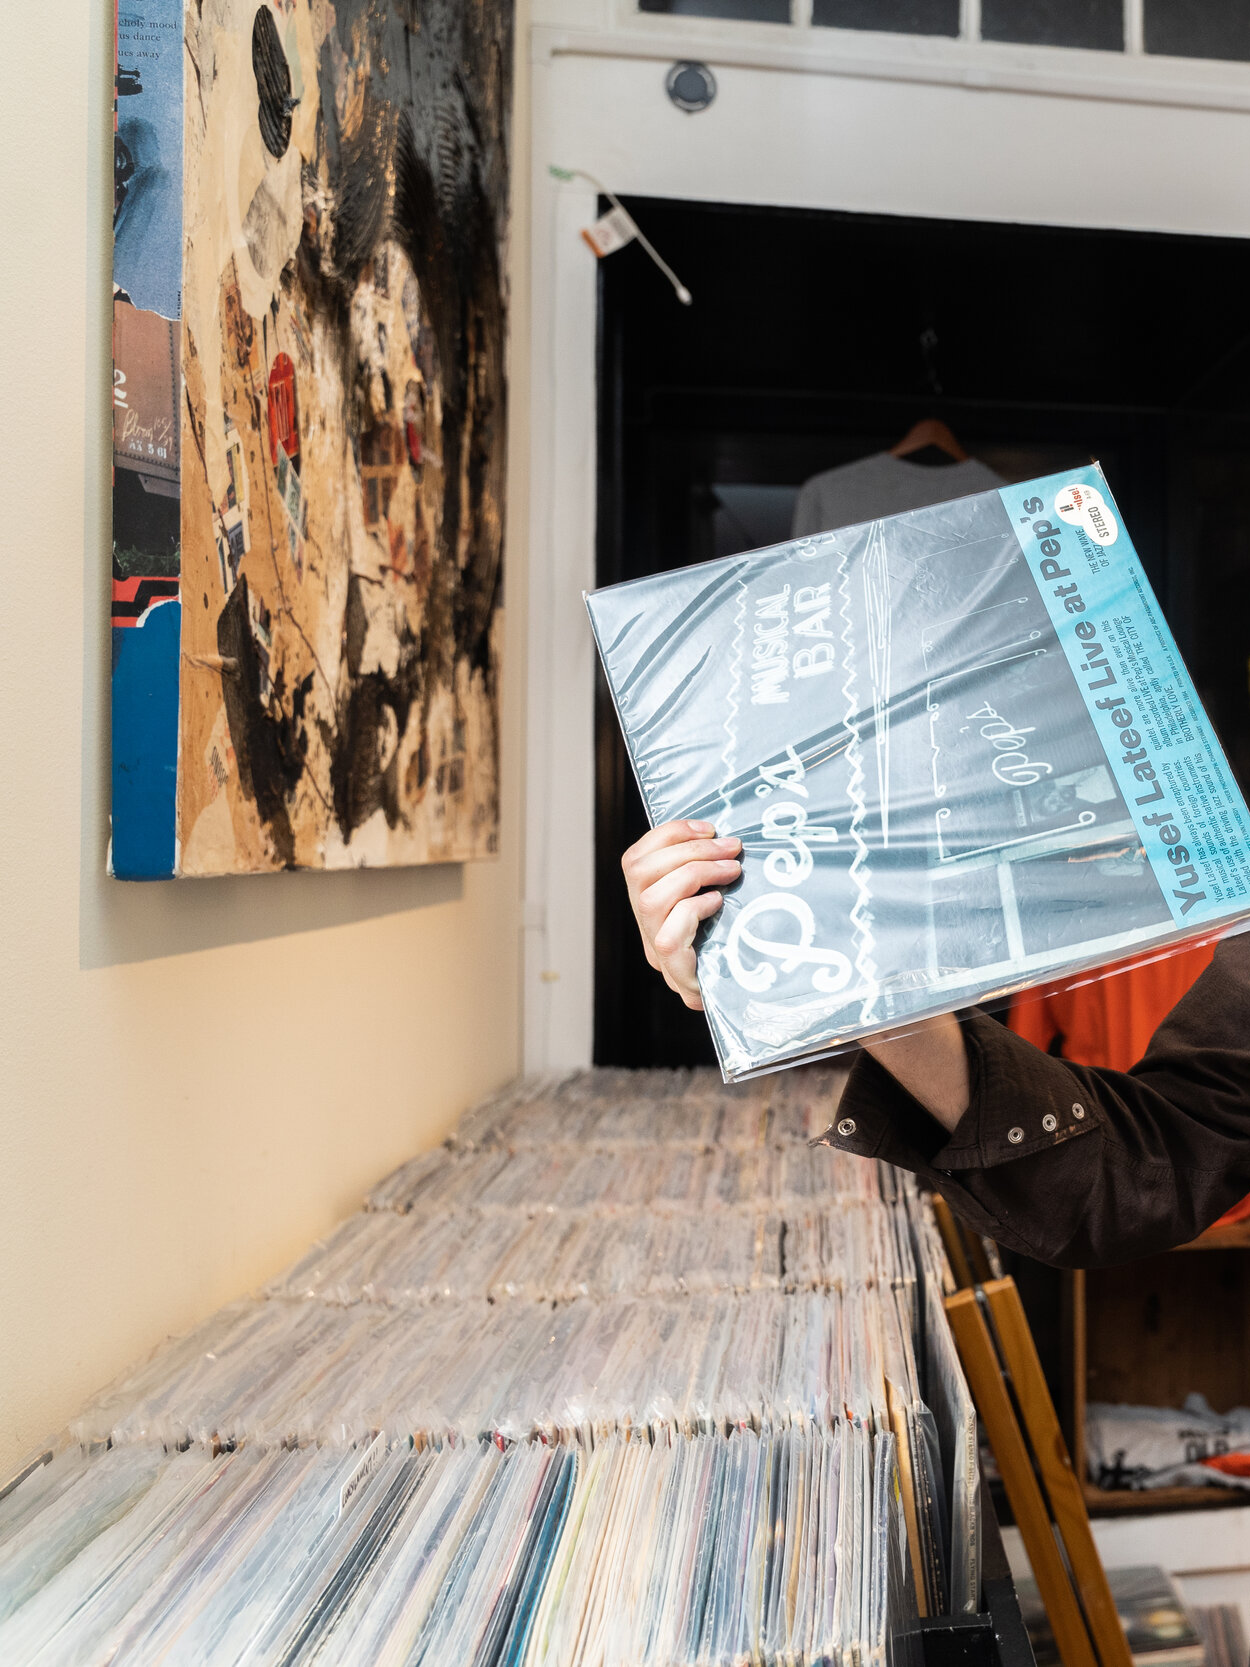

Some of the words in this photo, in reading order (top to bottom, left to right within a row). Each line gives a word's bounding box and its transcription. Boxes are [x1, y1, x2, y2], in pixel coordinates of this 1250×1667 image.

[150, 21, 176, 29] mood
[133, 32, 160, 41] dance
[136, 52, 160, 60] away
[1087, 506, 1109, 537] STEREO
[1020, 496, 1071, 580] Pep's
[1075, 528, 1089, 546] WAVE
[1082, 546, 1095, 561] NEW
[1093, 544, 1106, 557] JAZZ
[1088, 561, 1100, 574] THE
[1098, 558, 1109, 567] OF
[1053, 582, 1086, 613] at
[1100, 619, 1112, 632] this
[1112, 617, 1127, 639] Lounge
[1121, 614, 1132, 623] OF
[793, 582, 836, 679] BAR
[1107, 634, 1117, 642] on
[1125, 625, 1139, 639] CITY
[750, 583, 791, 706] MUSICAL
[1111, 645, 1124, 658] ever
[1120, 638, 1137, 662] Musical
[1132, 641, 1145, 654] THE
[1074, 620, 1117, 690] Live
[1118, 660, 1130, 675] than
[1130, 661, 1144, 679] Pep's
[1139, 656, 1154, 674] called
[1125, 677, 1138, 692] alive
[1140, 686, 1153, 700] LIVE
[1148, 677, 1162, 692] aptly
[1163, 684, 1178, 703] LOVE.
[1132, 694, 1146, 711] more
[1140, 713, 1151, 724] are
[1146, 700, 1164, 727] recorded
[1156, 695, 1179, 735] Philadelphia,
[1171, 704, 1194, 741] BROTHERLY
[960, 700, 1053, 786] Pep's
[1145, 727, 1162, 750] quintet
[1158, 727, 1172, 747] album
[1095, 697, 1164, 805] Lateef
[1193, 752, 1204, 763] his
[1160, 762, 1170, 771] by
[1172, 759, 1191, 791] countries.
[1182, 755, 1204, 794] instruments
[1163, 771, 1185, 806] enraptured
[1201, 774, 1217, 793] sound
[1186, 794, 1202, 817] foreign
[1198, 794, 1213, 815] native
[1211, 794, 1224, 809] jazz
[1179, 807, 1192, 823] been
[1217, 810, 1233, 833] driving
[1186, 823, 1202, 846] always
[1207, 815, 1226, 846] authentic
[1201, 831, 1217, 855] sounds
[1228, 835, 1239, 846] the
[1196, 846, 1207, 860] has
[1224, 854, 1235, 867] use
[1233, 848, 1246, 864] with
[725, 745, 853, 993] Pep's
[1142, 812, 1206, 914] Yusef
[1200, 860, 1216, 882] Lateef
[1211, 858, 1229, 883] musical
[1229, 868, 1247, 895] Lateef's
[1209, 882, 1224, 902] Yusef
[1224, 886, 1236, 898] the
